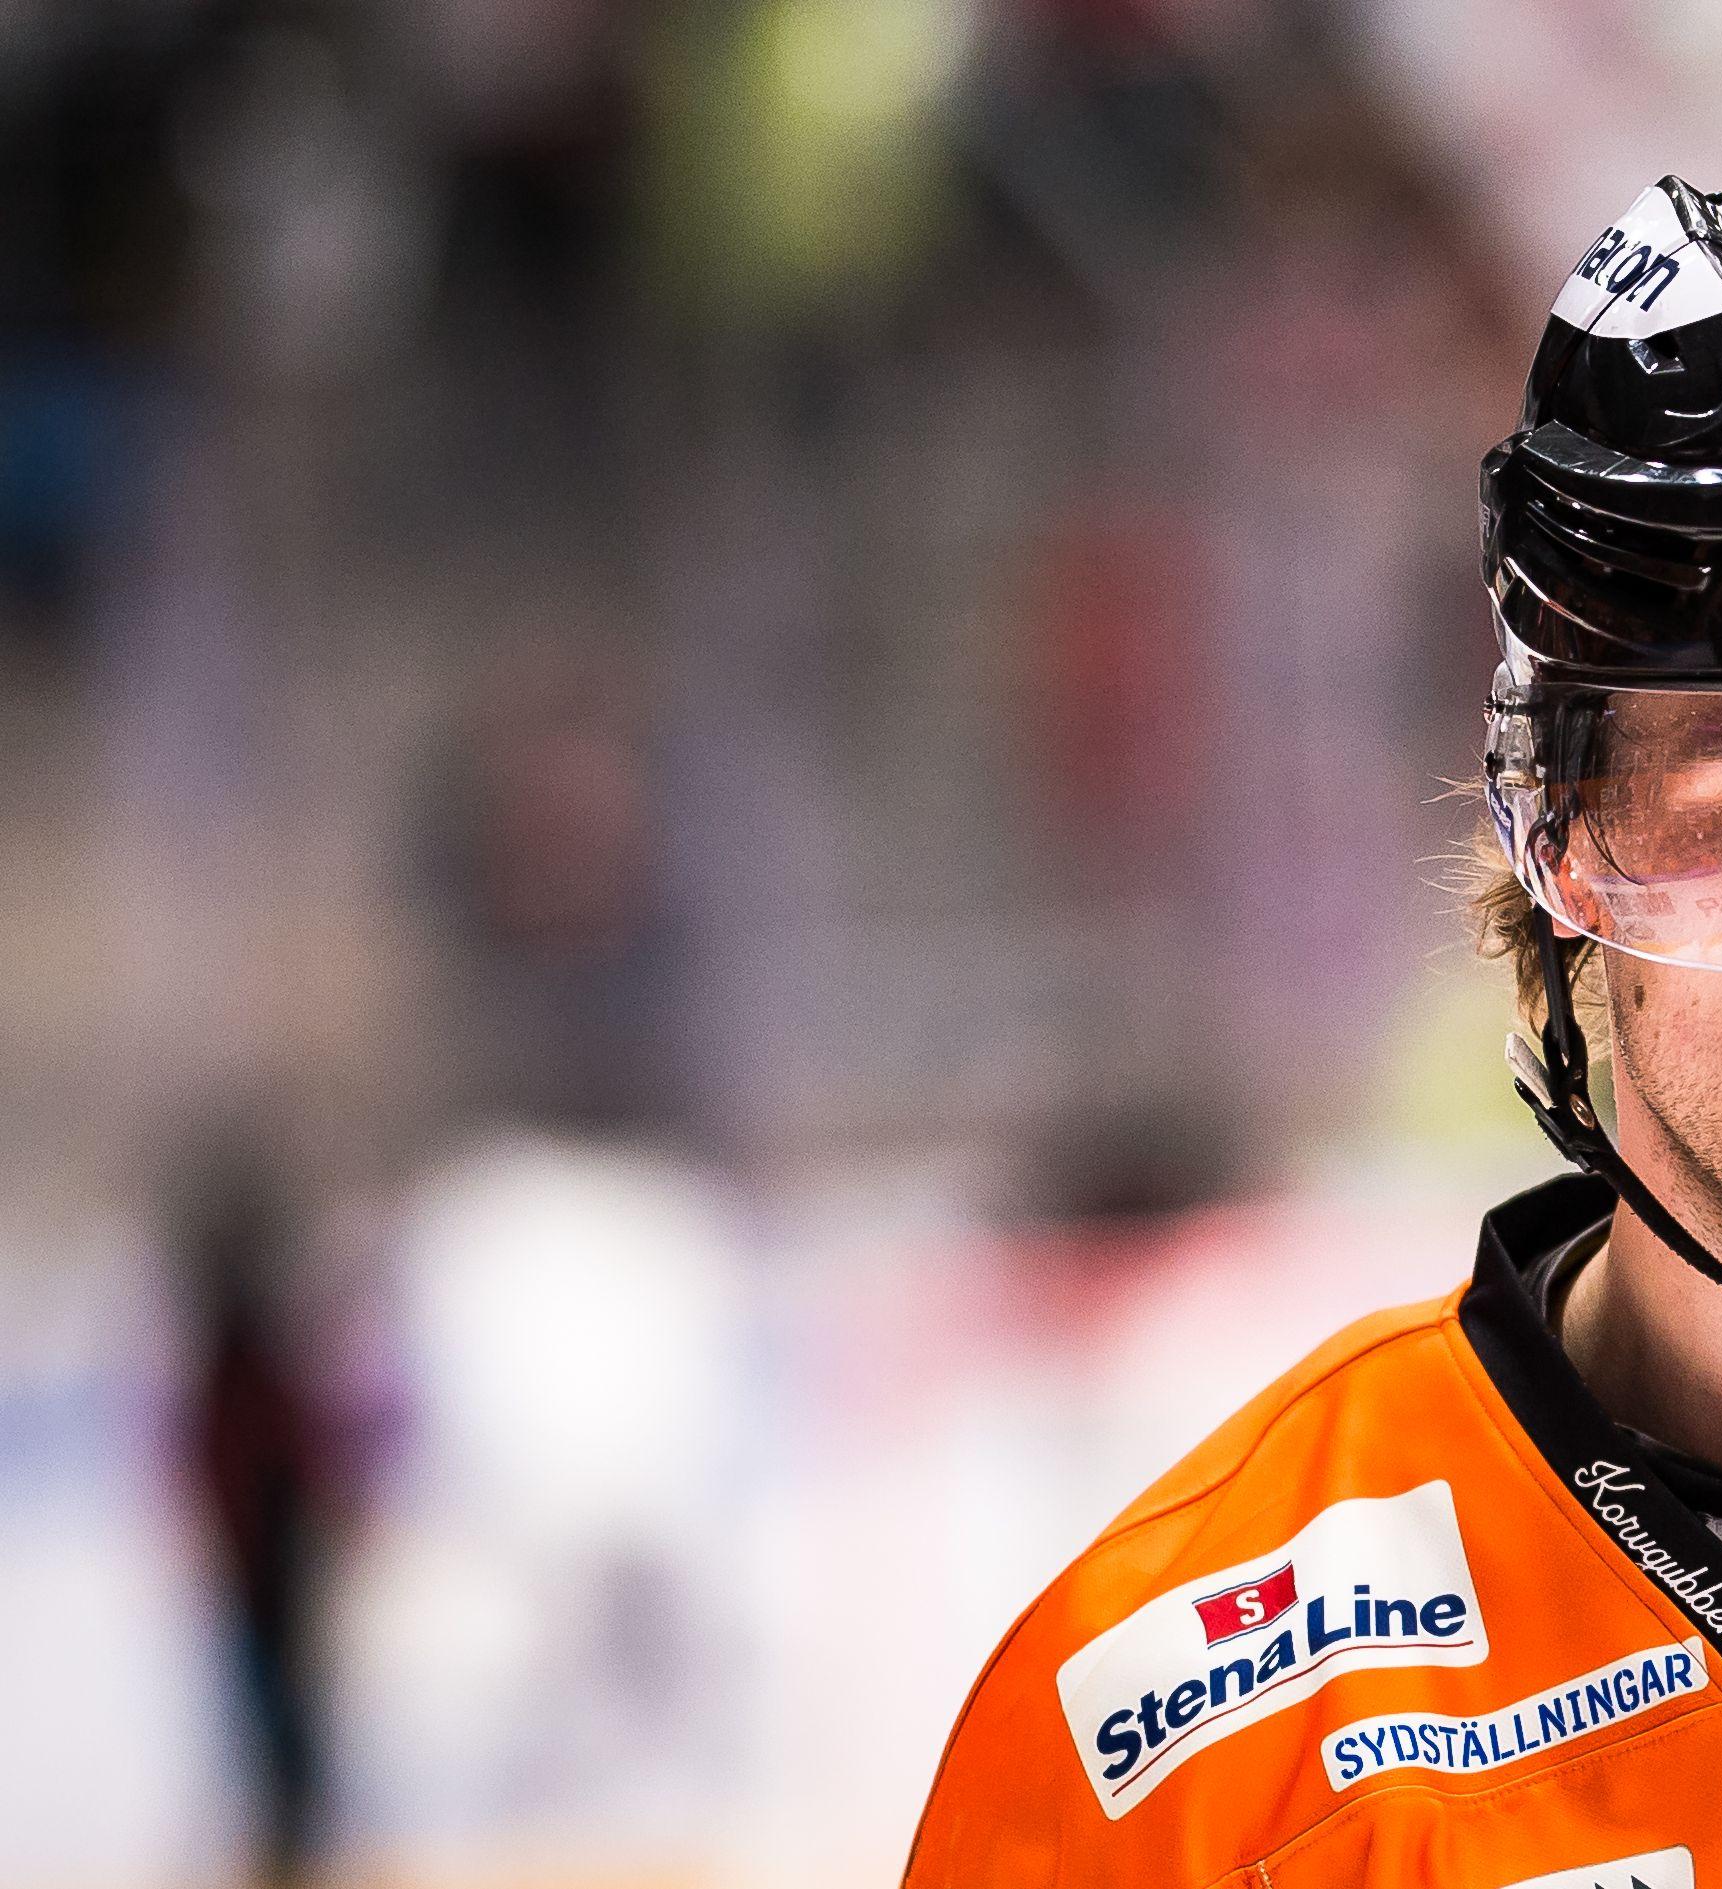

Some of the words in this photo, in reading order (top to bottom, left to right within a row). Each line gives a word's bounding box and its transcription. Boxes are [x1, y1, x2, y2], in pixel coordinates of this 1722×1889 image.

[1235, 1588, 1266, 1627] S
[1096, 1629, 1297, 1780] Stena
[1306, 1584, 1467, 1656] Line
[1334, 1652, 1695, 1780] SYDSTÄLLNINGAR
